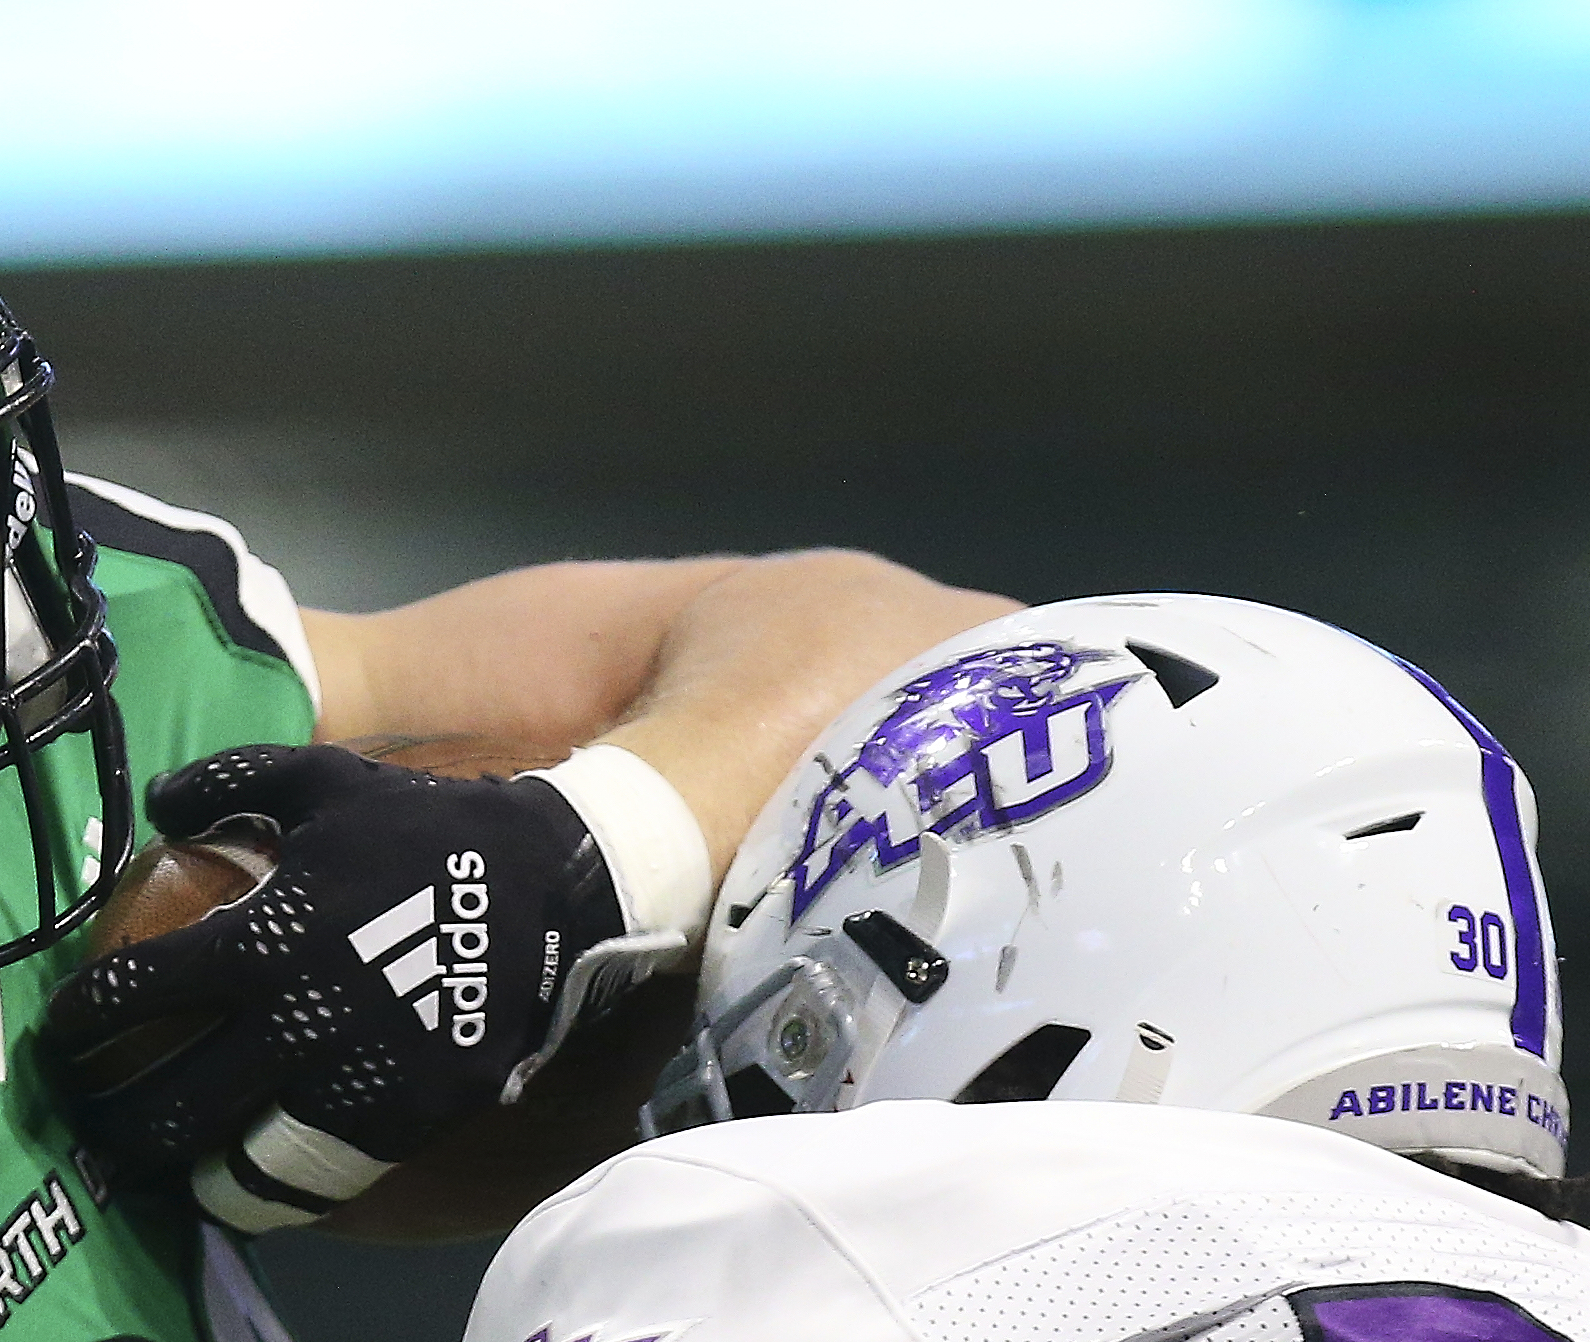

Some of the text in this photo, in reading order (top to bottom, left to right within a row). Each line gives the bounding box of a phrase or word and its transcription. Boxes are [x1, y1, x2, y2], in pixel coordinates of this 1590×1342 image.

[440, 849, 490, 1048] adidas
[1447, 904, 1508, 980] 30
[1328, 1081, 1518, 1121] ABILENE
